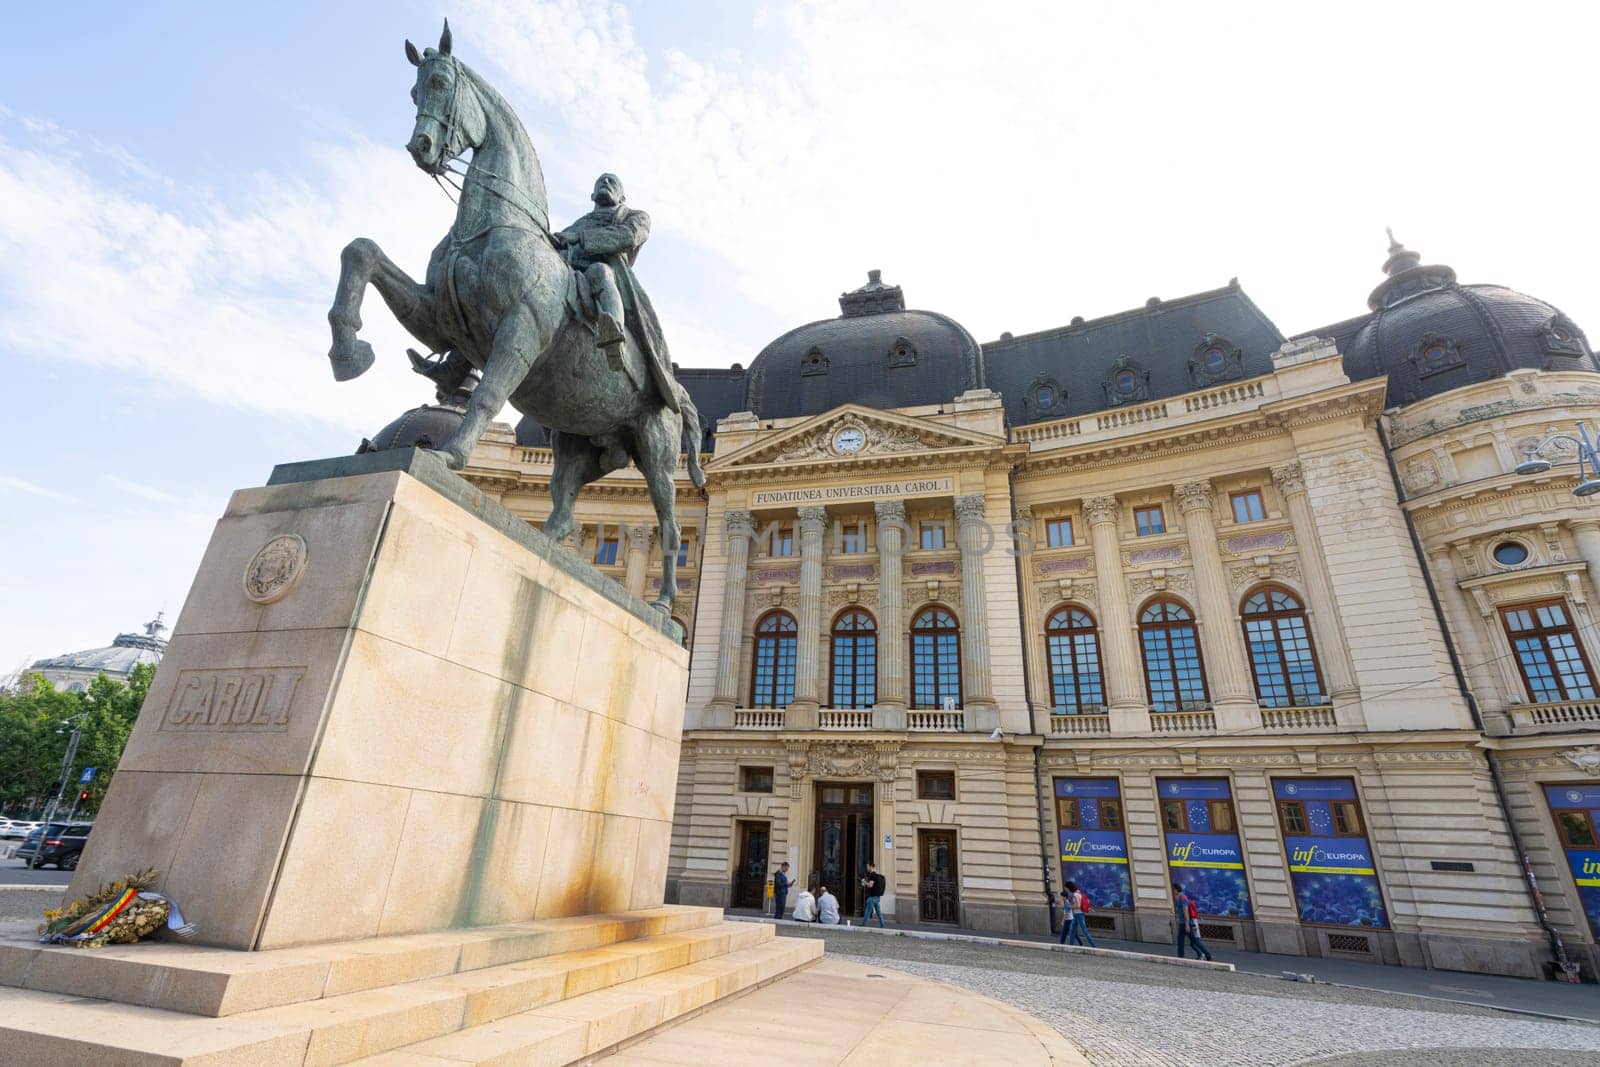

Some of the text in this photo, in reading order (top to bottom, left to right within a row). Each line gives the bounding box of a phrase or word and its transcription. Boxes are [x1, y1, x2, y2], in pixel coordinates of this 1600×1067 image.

[756, 490, 822, 503] FUNDATIUNEA
[826, 484, 900, 498] UNIVERSITARA
[905, 481, 941, 492] CAROL
